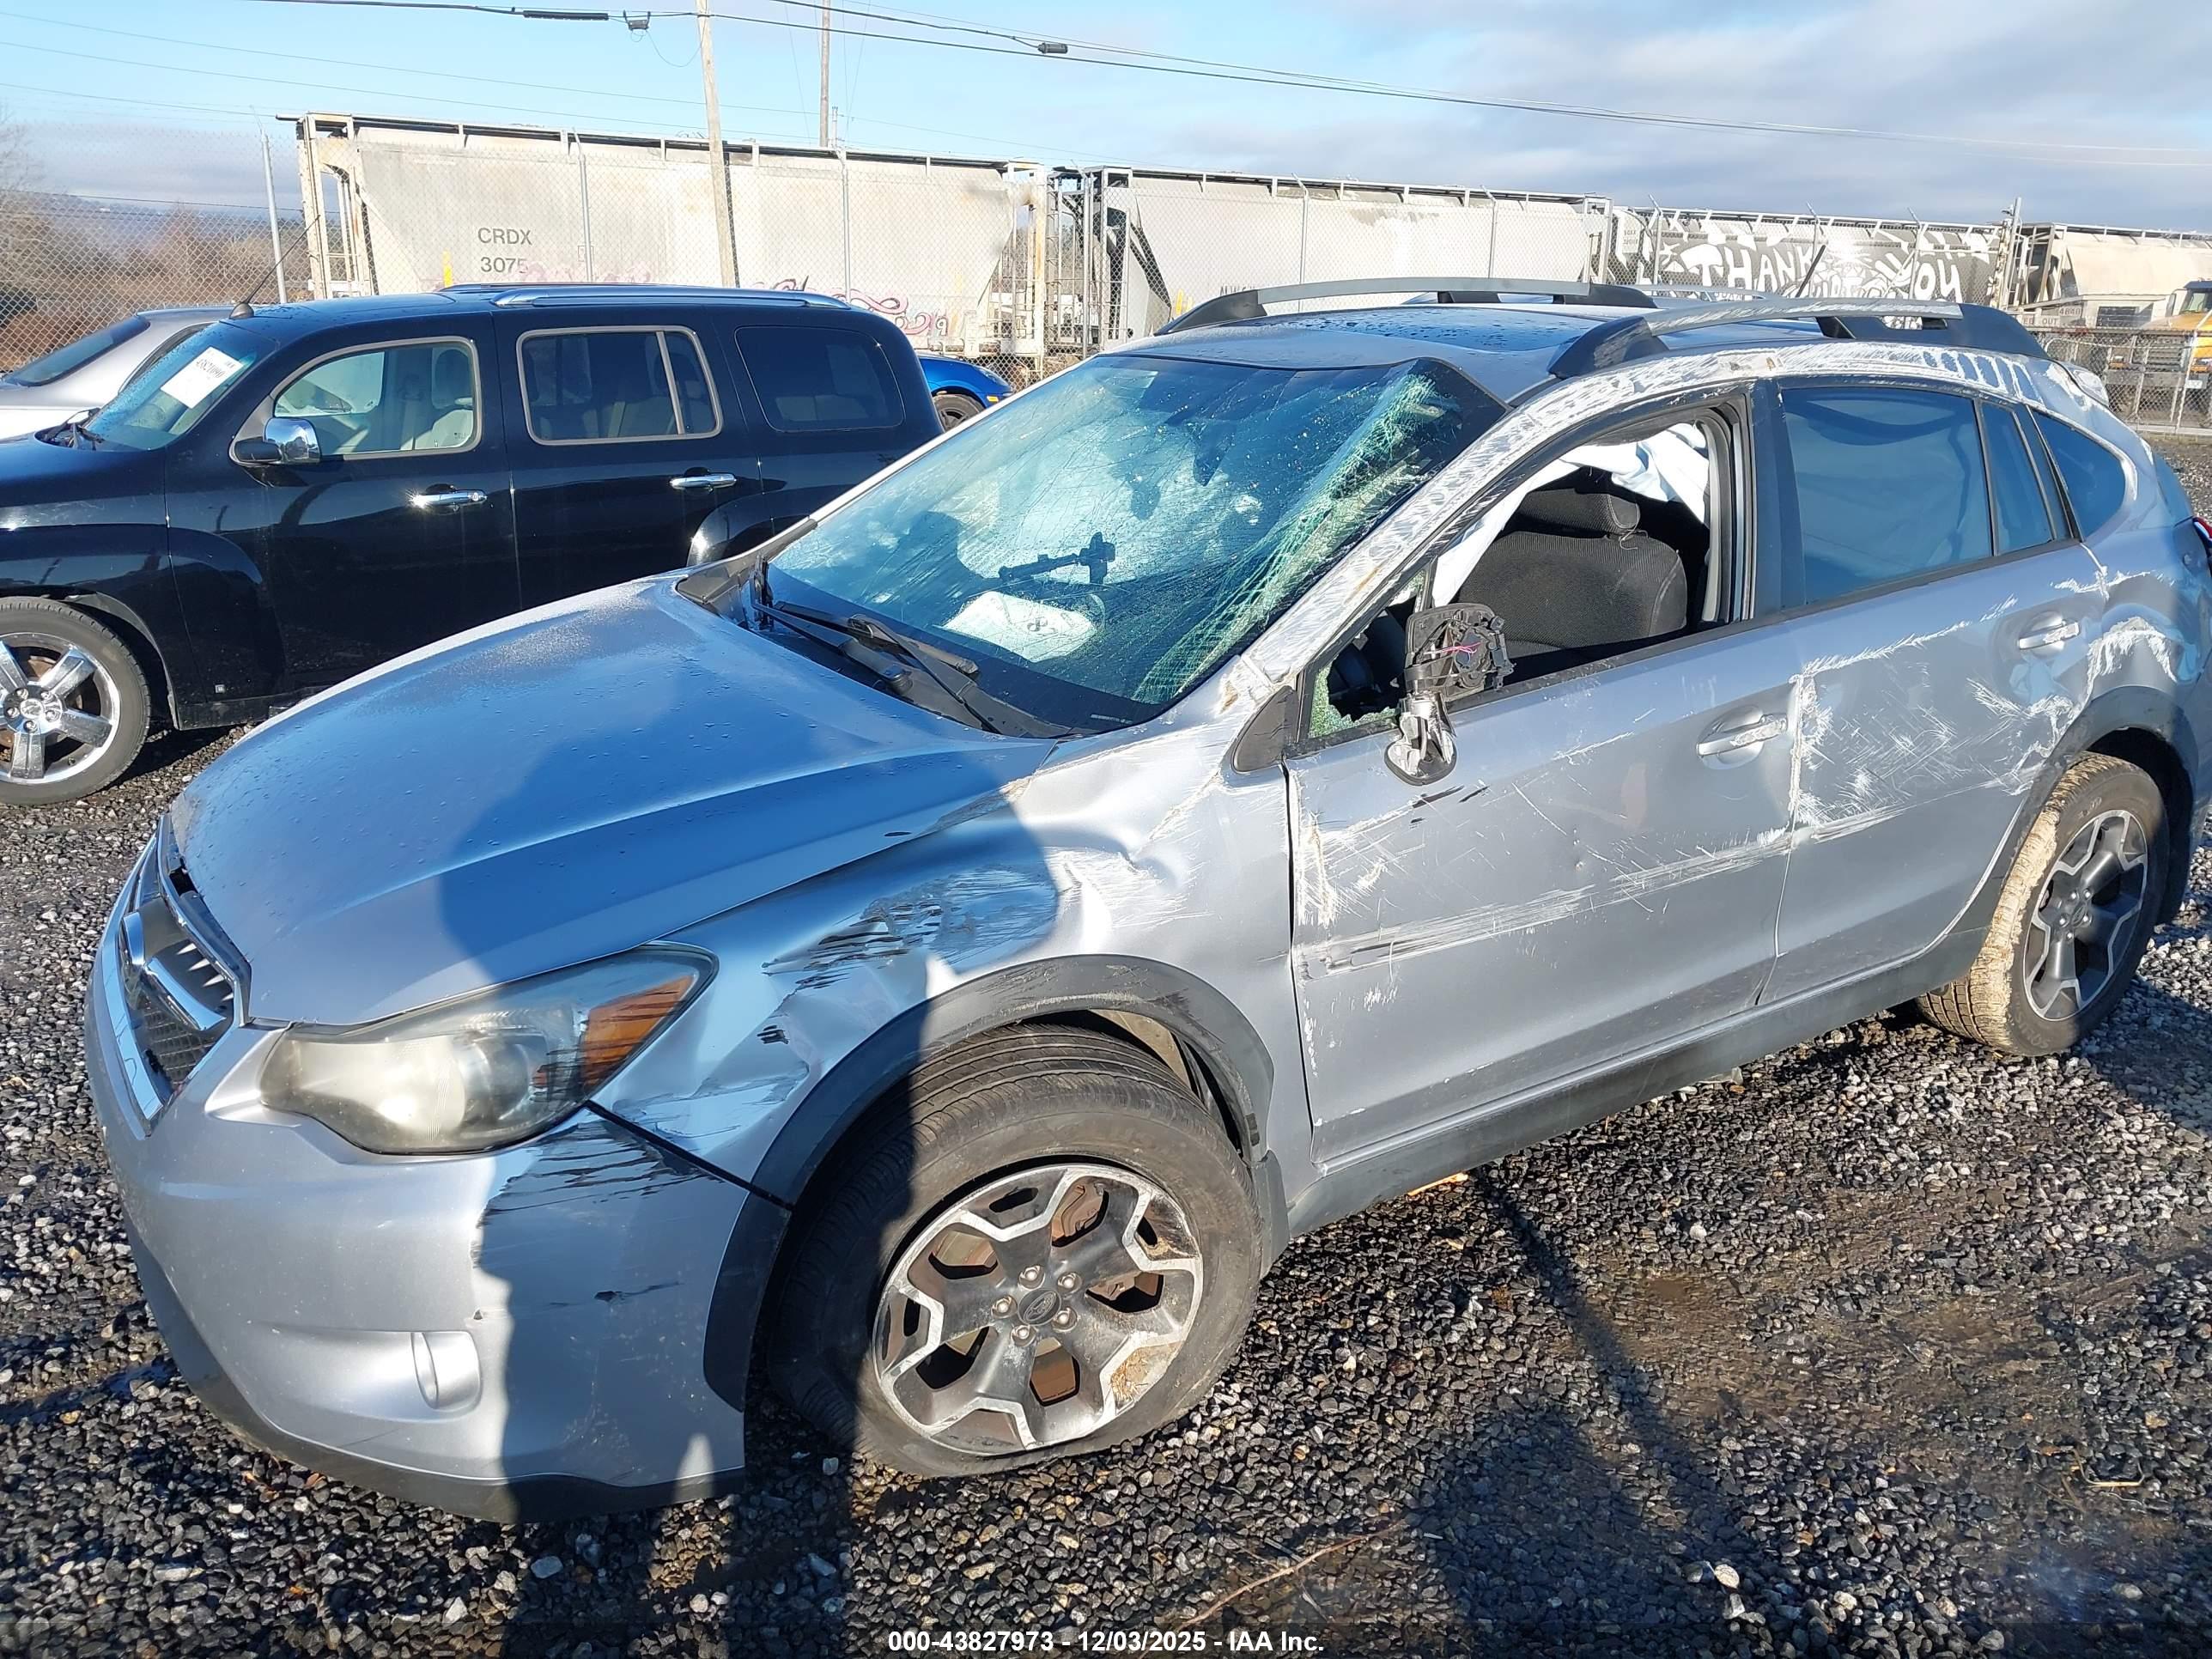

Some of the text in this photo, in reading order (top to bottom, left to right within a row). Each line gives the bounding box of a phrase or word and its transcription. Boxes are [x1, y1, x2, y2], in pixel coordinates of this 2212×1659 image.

[477, 227, 532, 246] CRDX
[480, 257, 529, 274] 3075
[1680, 243, 1817, 298] THANK
[1874, 251, 1963, 301] YOU
[2041, 317, 2059, 325] OUT
